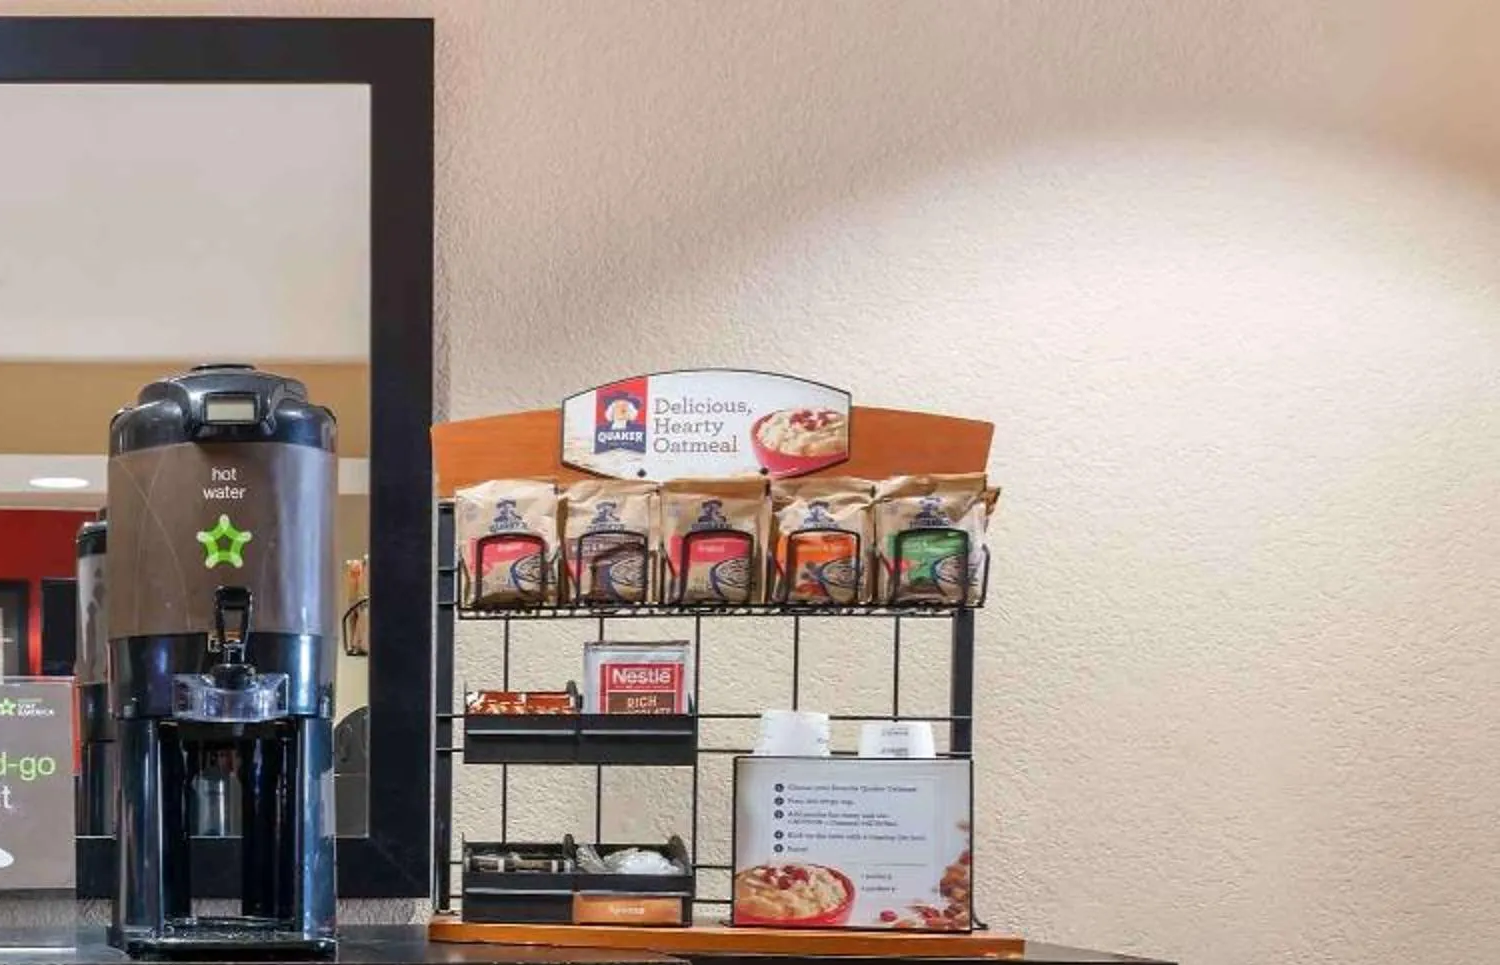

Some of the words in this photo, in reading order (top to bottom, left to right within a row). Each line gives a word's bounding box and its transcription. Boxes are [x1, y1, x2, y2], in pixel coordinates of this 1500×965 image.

[654, 397, 752, 416] Delicious,
[653, 417, 724, 436] Hearty
[597, 431, 644, 443] QUAKER
[653, 435, 740, 453] Oatmeal
[211, 467, 237, 481] hot
[203, 485, 247, 500] water
